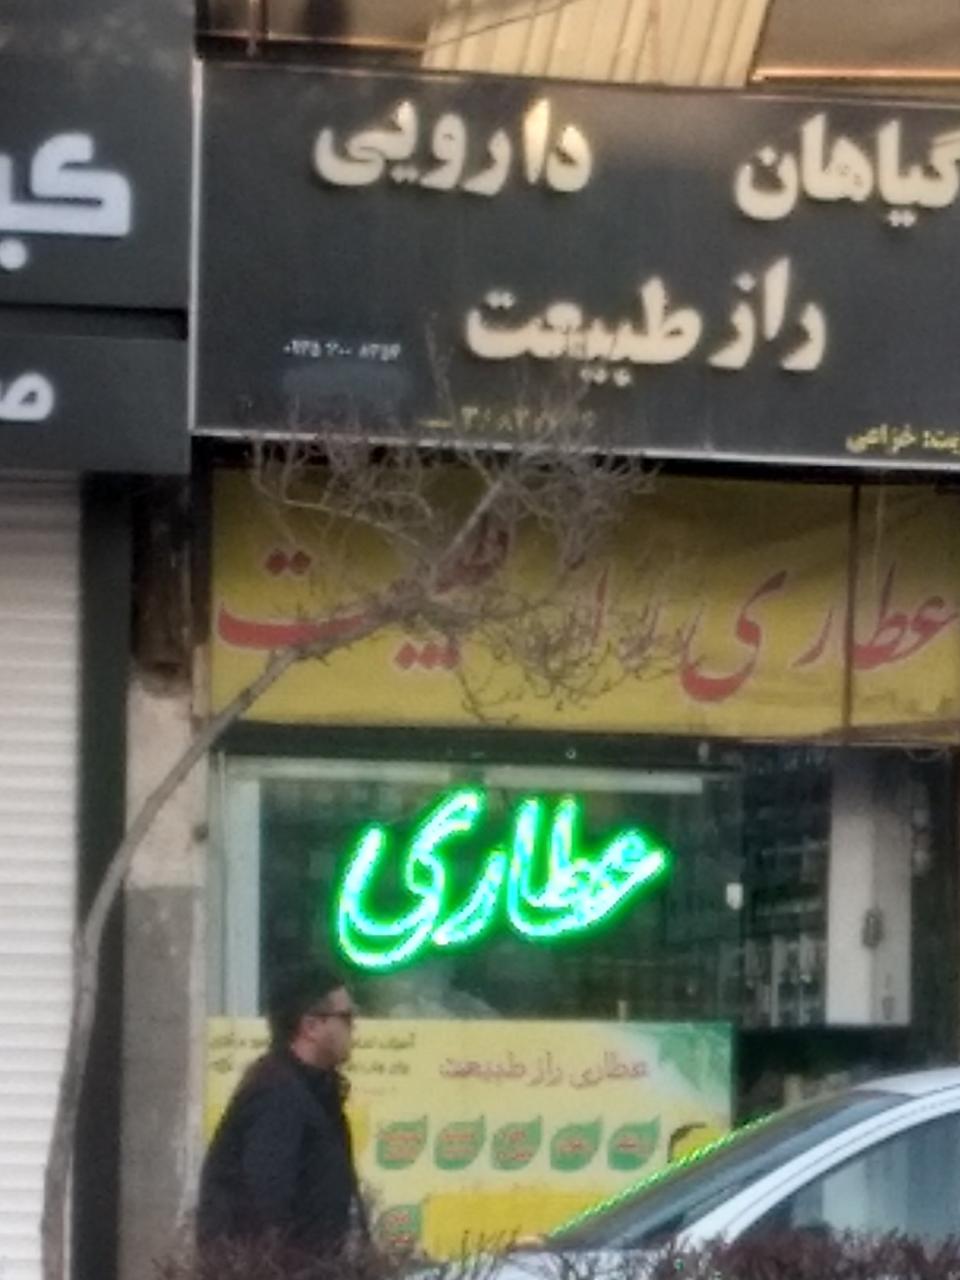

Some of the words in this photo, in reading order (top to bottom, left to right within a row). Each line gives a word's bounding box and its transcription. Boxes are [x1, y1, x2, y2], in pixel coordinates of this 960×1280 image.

[314, 98, 593, 197] دارویی
[465, 275, 703, 386] طبیعت
[706, 256, 826, 372] راز
[335, 784, 668, 970] عطاری
